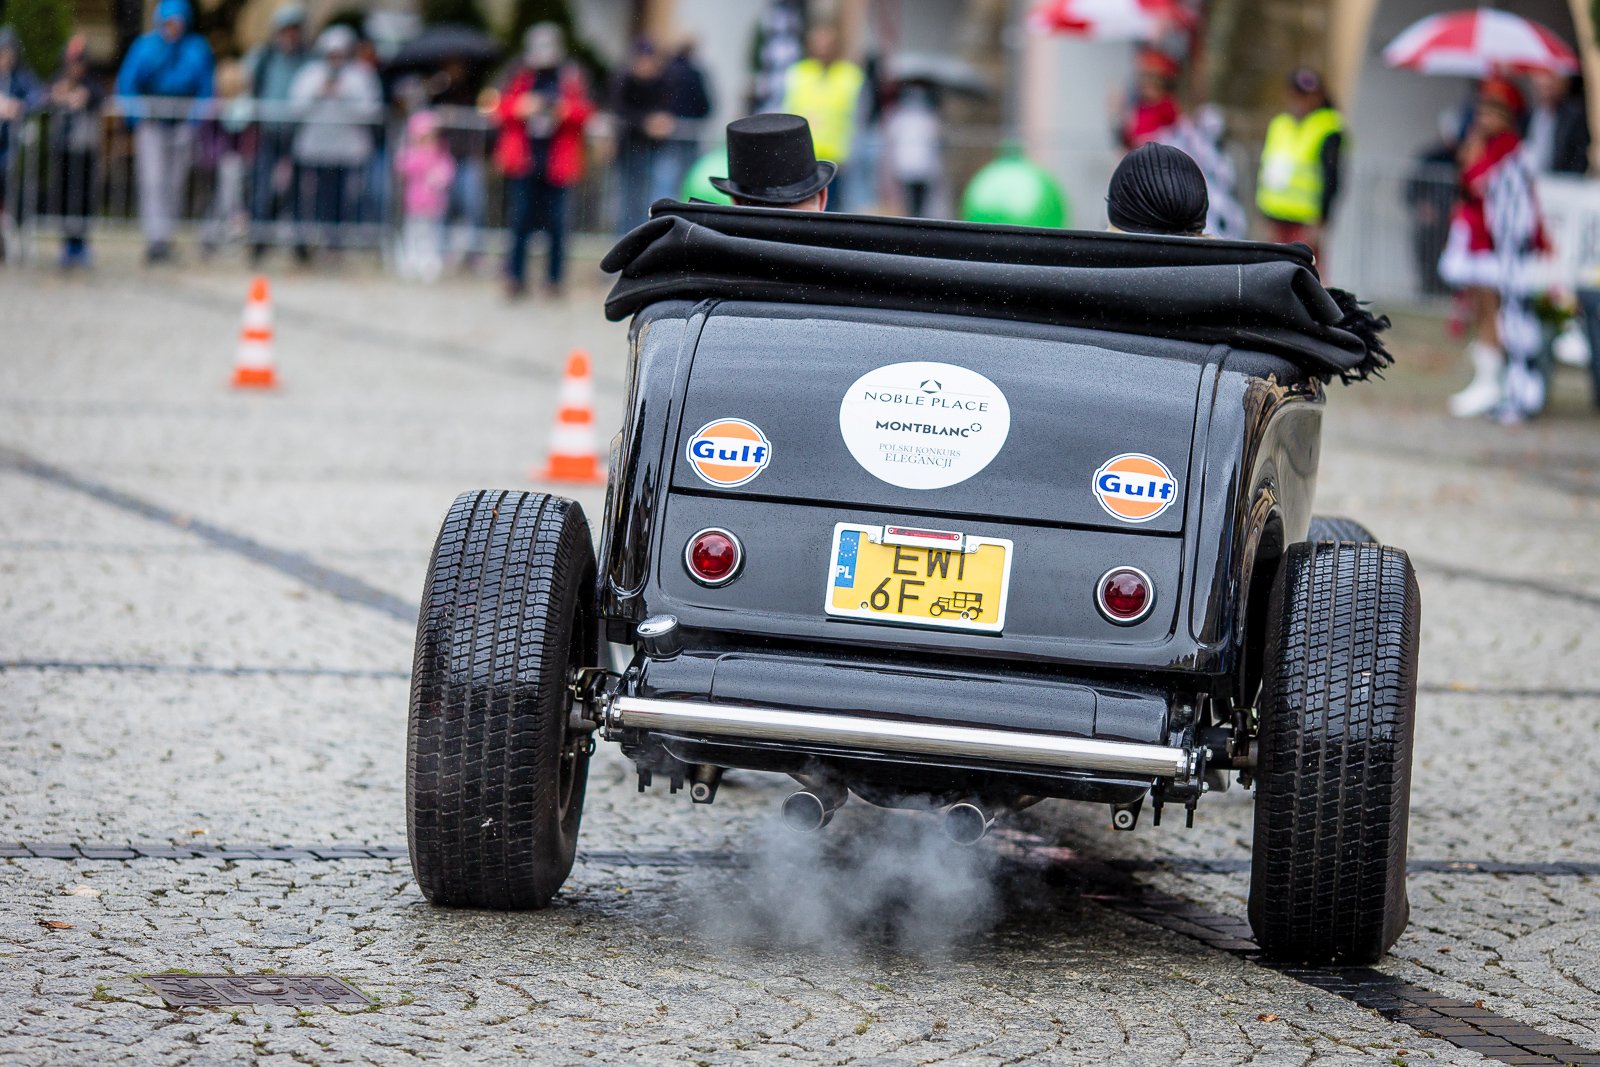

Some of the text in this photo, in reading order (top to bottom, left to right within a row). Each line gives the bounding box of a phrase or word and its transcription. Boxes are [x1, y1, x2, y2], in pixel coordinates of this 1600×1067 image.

[864, 391, 989, 412] NOBLE PLACE
[875, 420, 970, 438] MONTBLANC
[693, 440, 766, 463] Gulf
[879, 442, 961, 457] POLSKI KONKURS
[885, 453, 952, 468] ELEGANCJI
[1099, 474, 1173, 500] Gulf
[836, 565, 852, 579] PL
[893, 546, 966, 581] EWI
[870, 577, 925, 613] 6F
